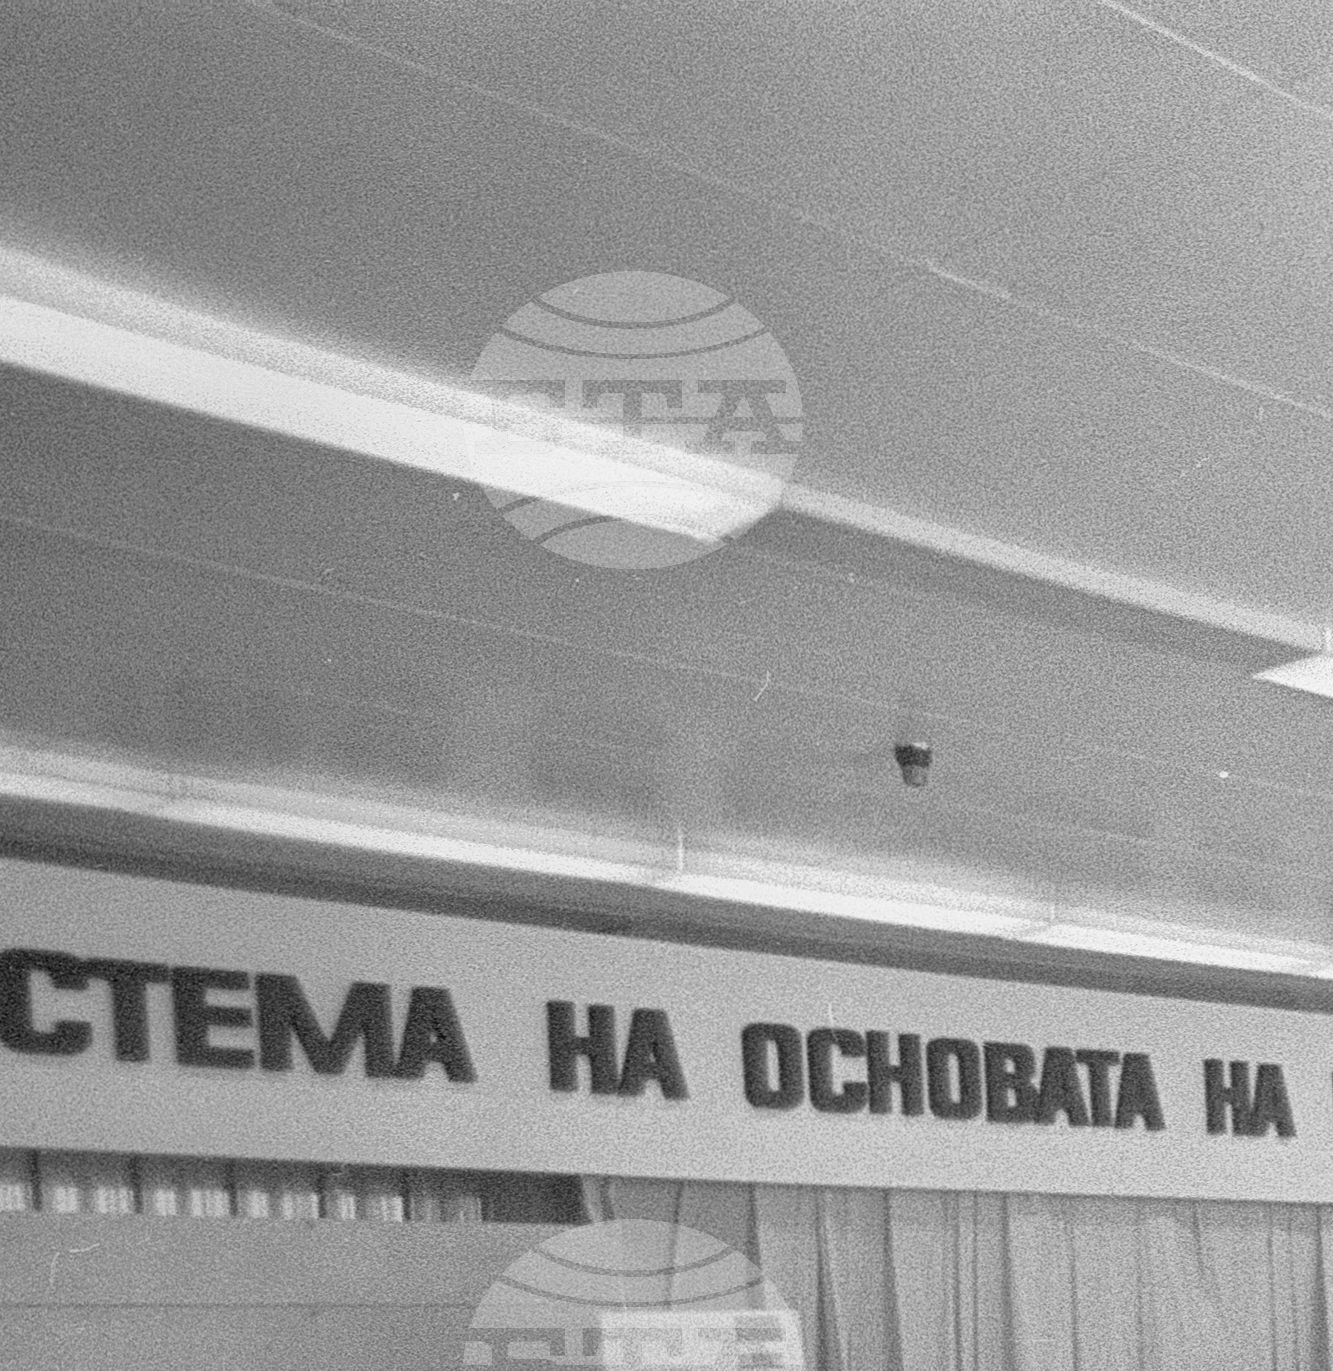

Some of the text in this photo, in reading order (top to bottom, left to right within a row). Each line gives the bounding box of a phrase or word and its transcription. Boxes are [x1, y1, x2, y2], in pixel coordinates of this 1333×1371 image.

[0, 946, 478, 1084] СТЕМА
[544, 1000, 690, 1101] НА
[740, 1022, 1166, 1131] ОСНОВАТА
[1203, 1059, 1296, 1138] НА
